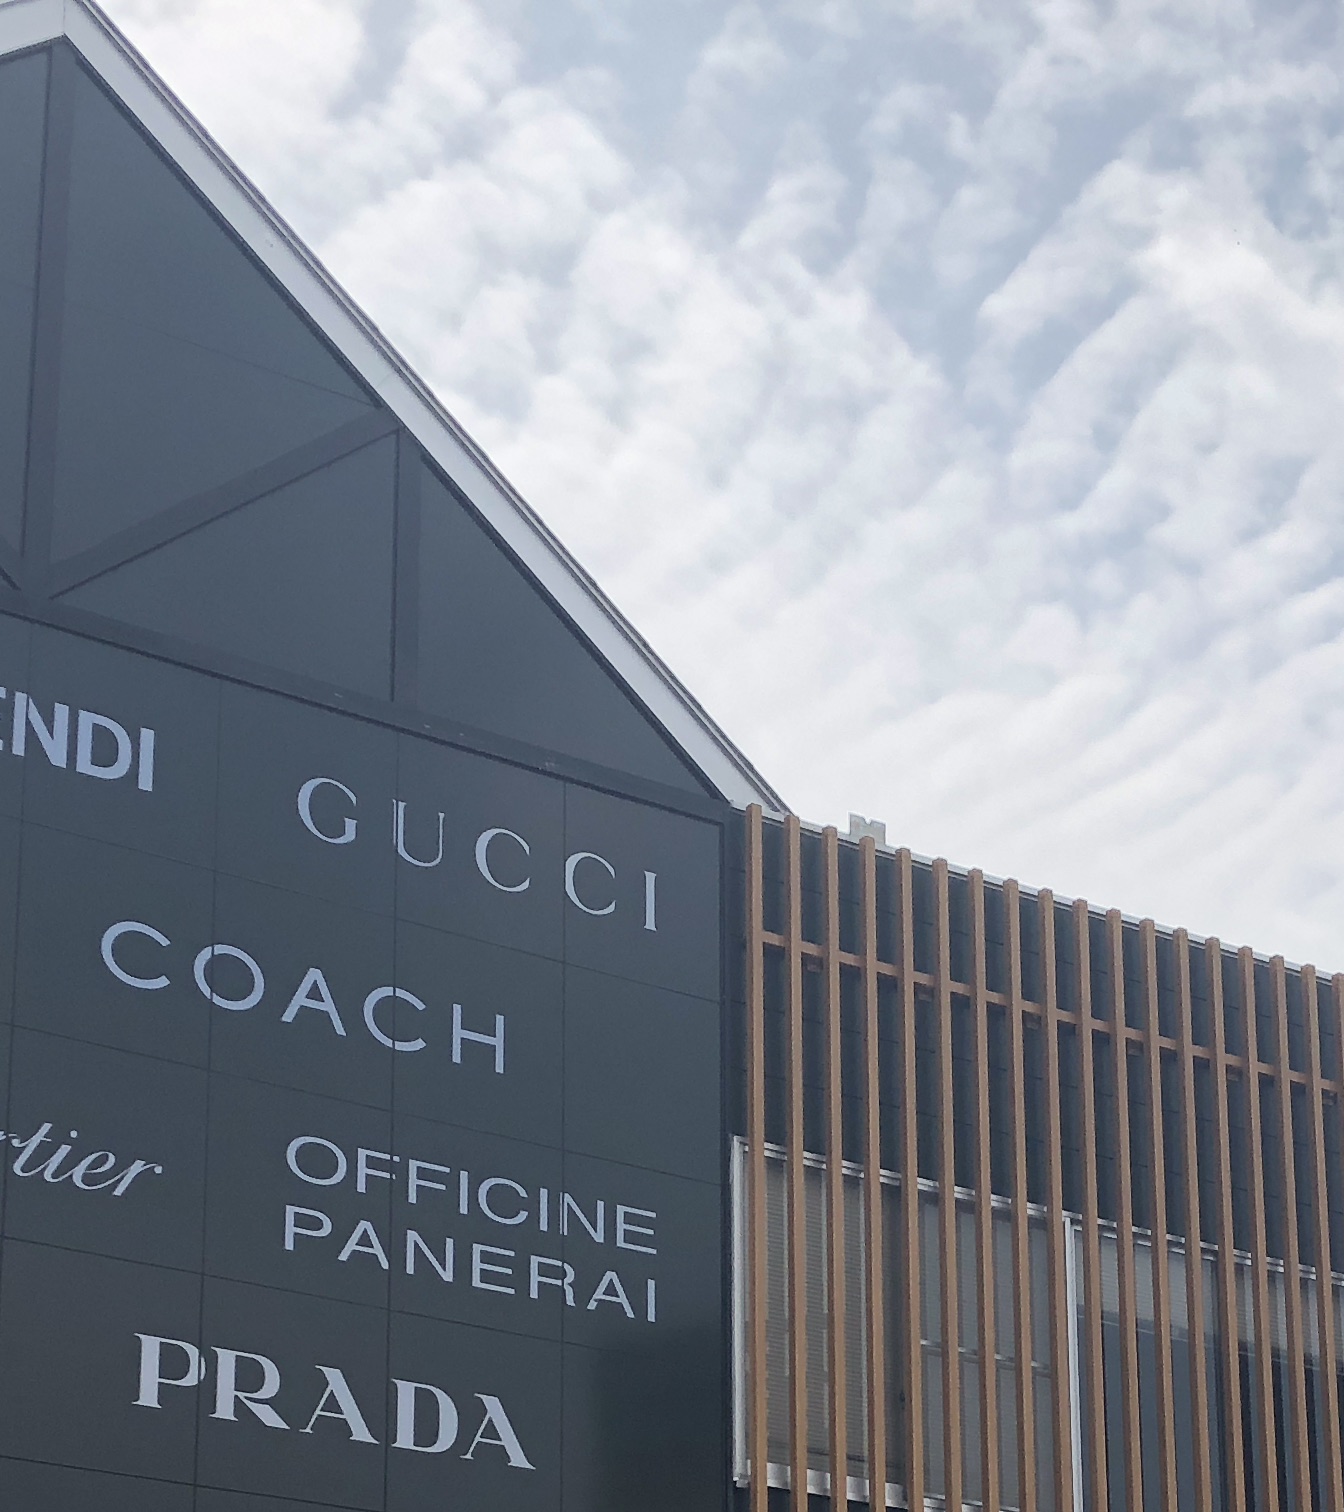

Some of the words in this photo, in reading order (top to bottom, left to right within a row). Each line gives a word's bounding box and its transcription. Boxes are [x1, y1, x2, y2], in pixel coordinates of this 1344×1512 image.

[297, 777, 658, 932] GUCCI
[101, 921, 506, 1074] COACH
[284, 1204, 657, 1323] PANERAI
[285, 1136, 658, 1255] OFFICINE
[132, 1332, 536, 1470] PRADA
